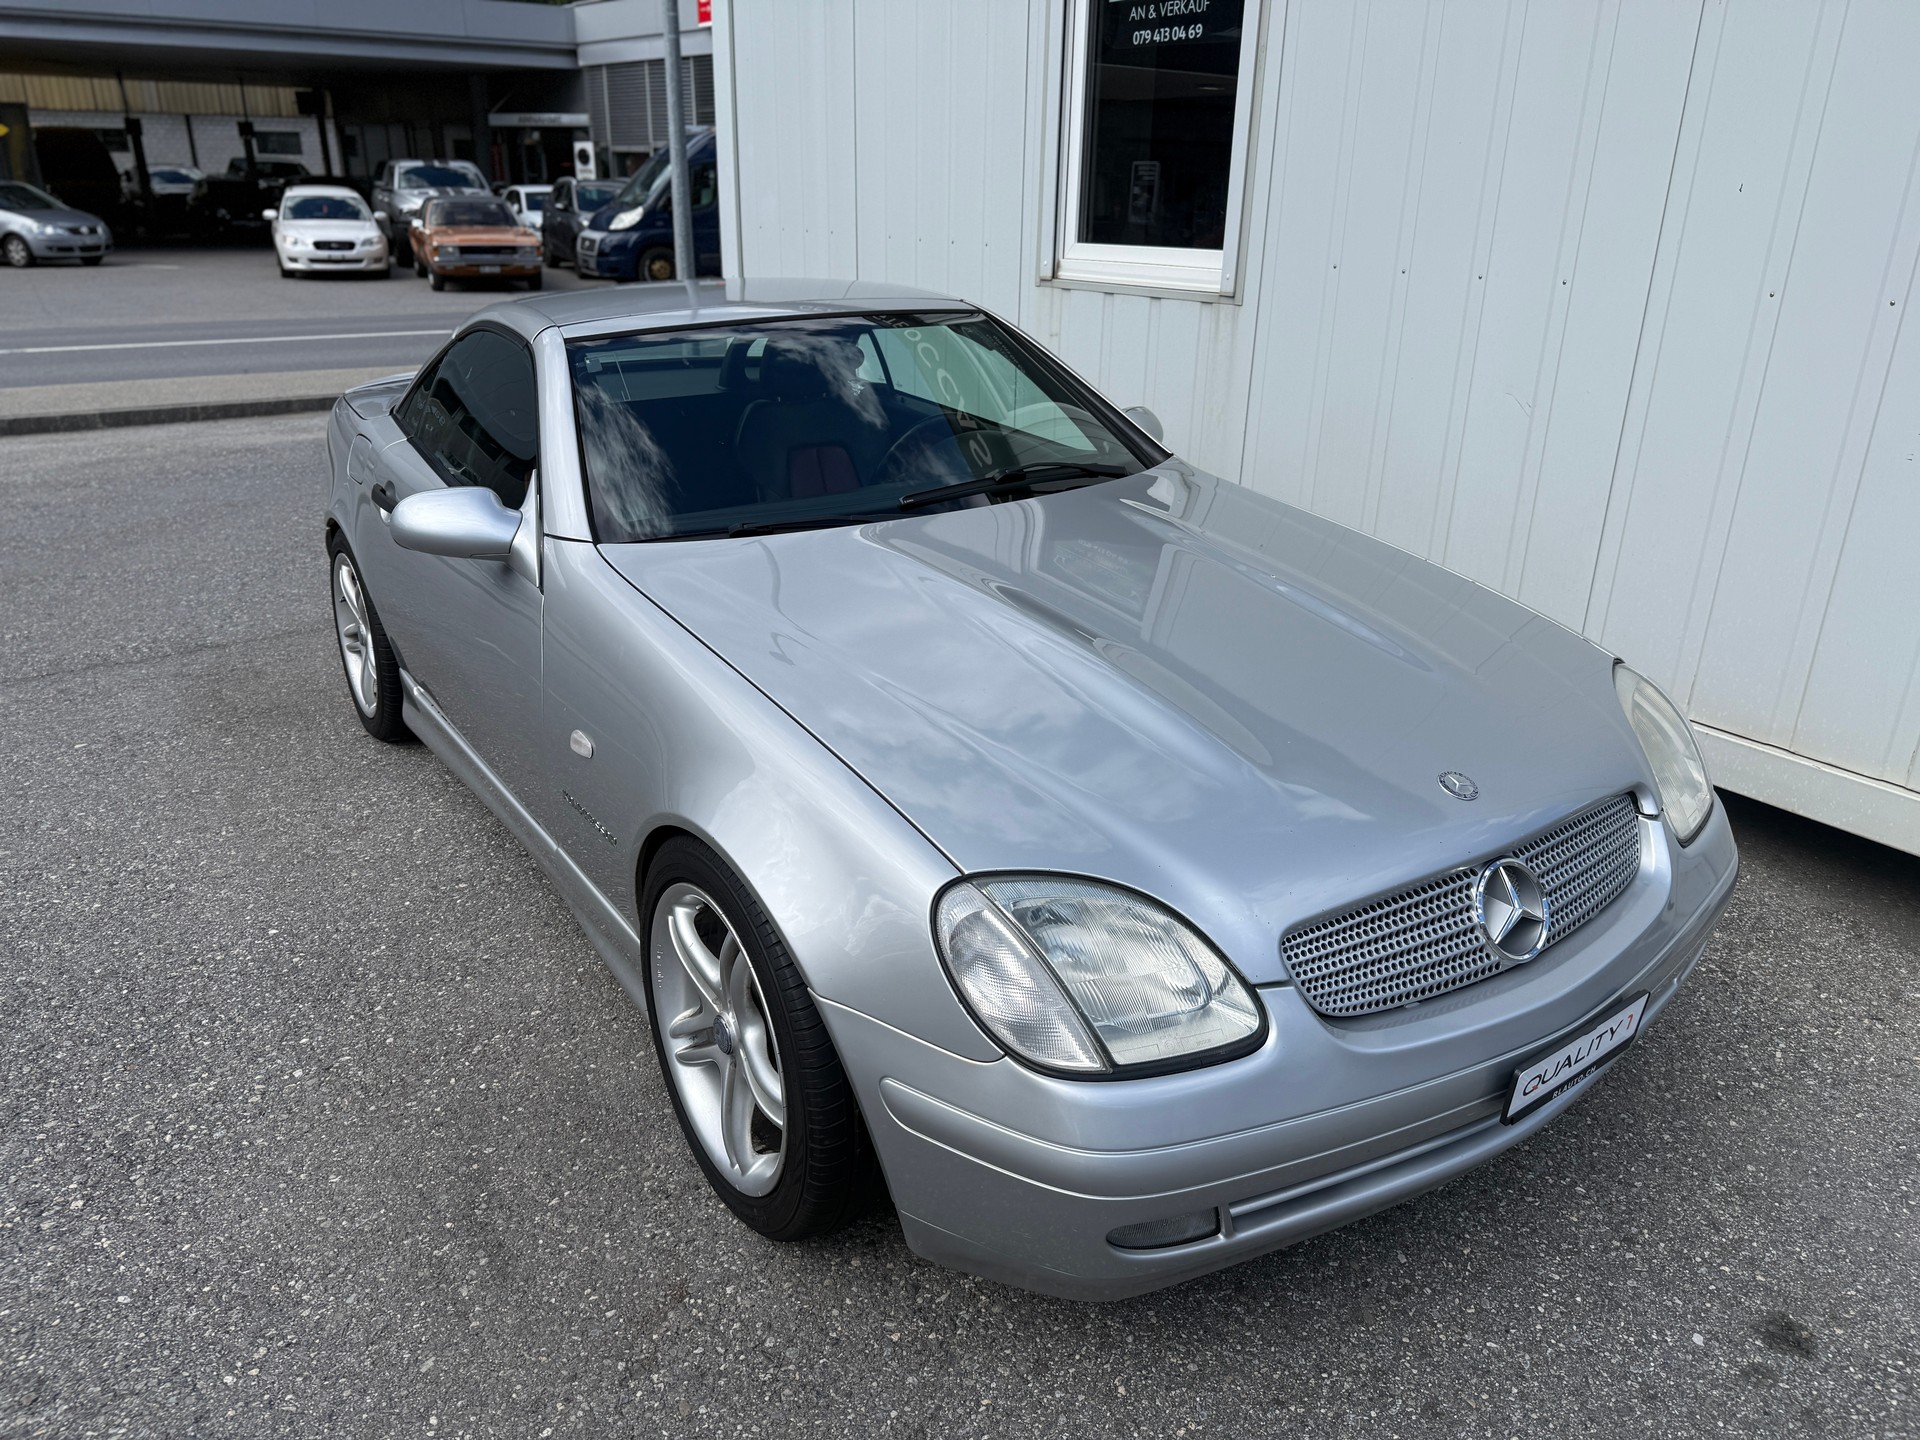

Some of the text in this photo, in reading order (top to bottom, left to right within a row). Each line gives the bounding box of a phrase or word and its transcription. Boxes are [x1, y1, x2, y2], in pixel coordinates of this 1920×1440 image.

[1129, 0, 1210, 21] AN & VERKAUF
[1132, 23, 1204, 45] 079 413 04 69
